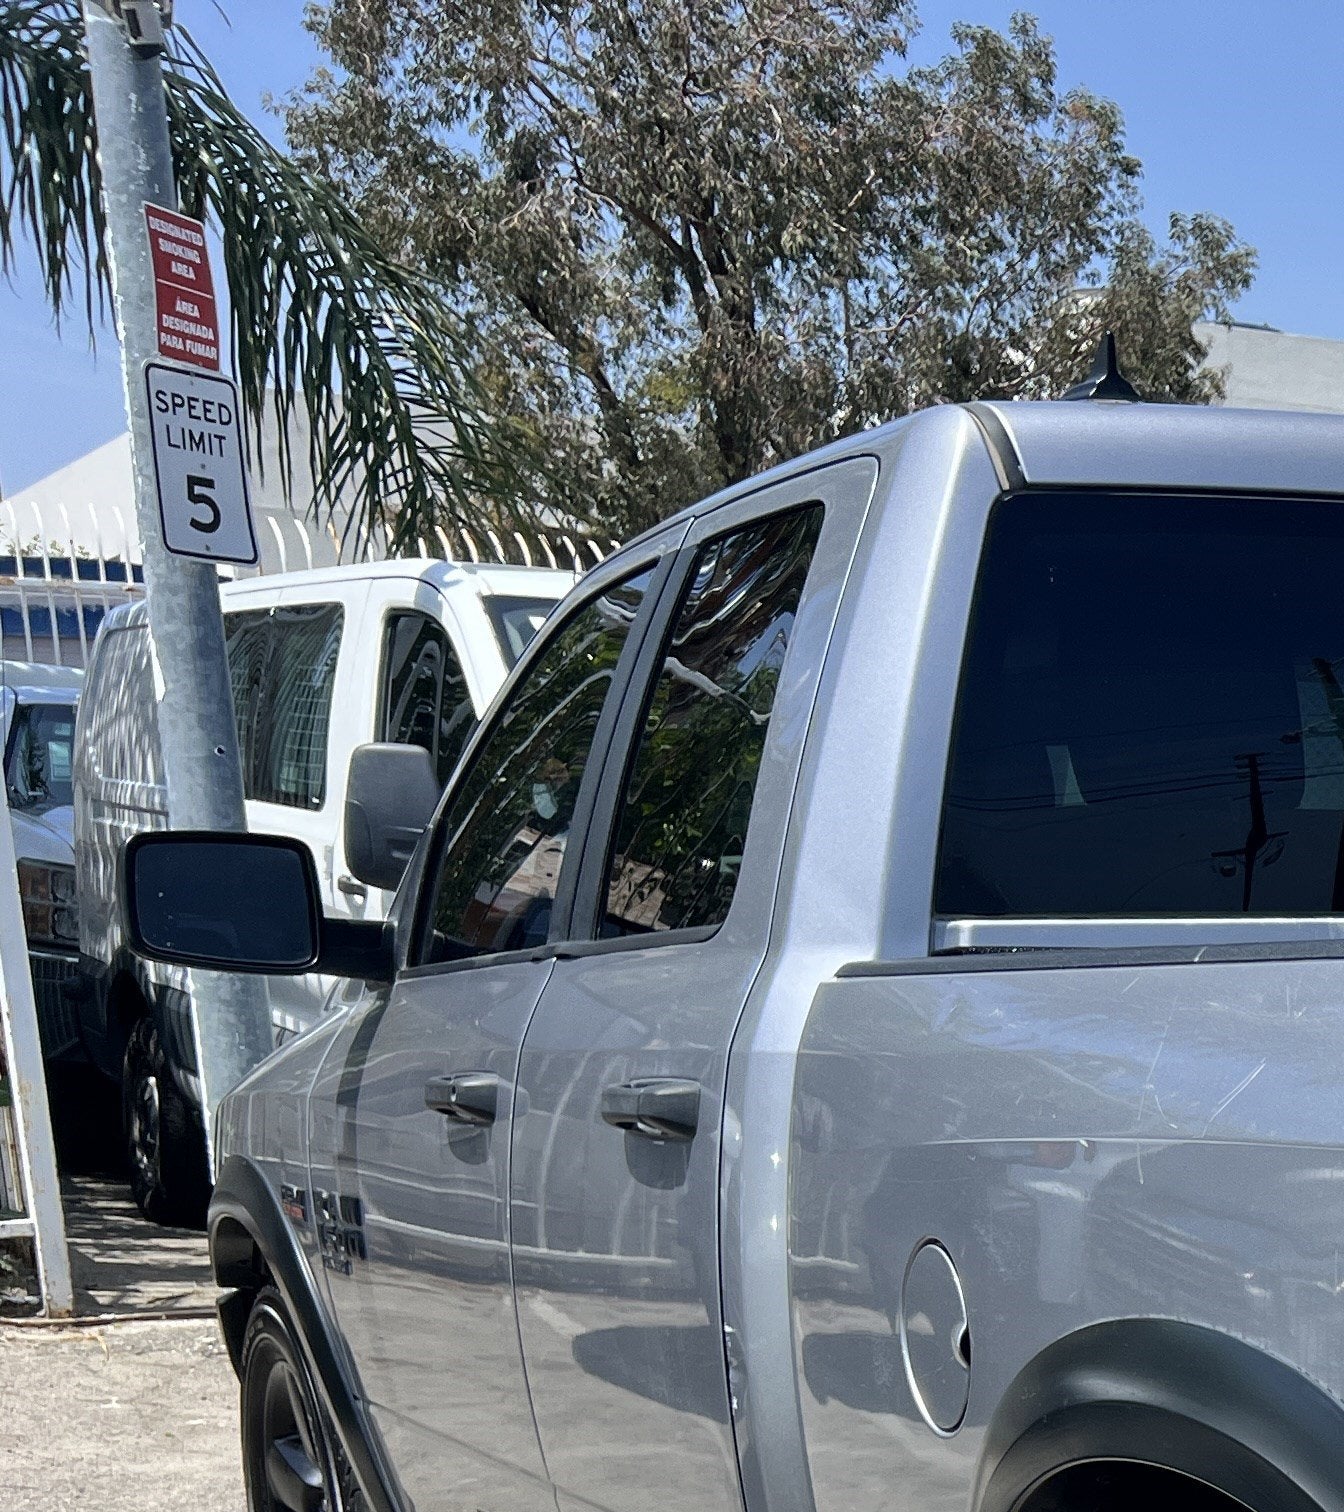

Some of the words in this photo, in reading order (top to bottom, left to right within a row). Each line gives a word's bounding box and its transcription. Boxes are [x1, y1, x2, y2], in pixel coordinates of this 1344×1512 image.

[148, 215, 204, 247] DESIGNATED
[158, 237, 201, 264] SMOKING
[171, 260, 196, 281] AREA
[162, 313, 215, 341] DESIGNADA
[160, 331, 185, 351] PARA
[186, 337, 218, 360] FUMAR
[155, 390, 232, 426] SPEED
[166, 424, 226, 457] LIMIT
[187, 474, 221, 533] 5
